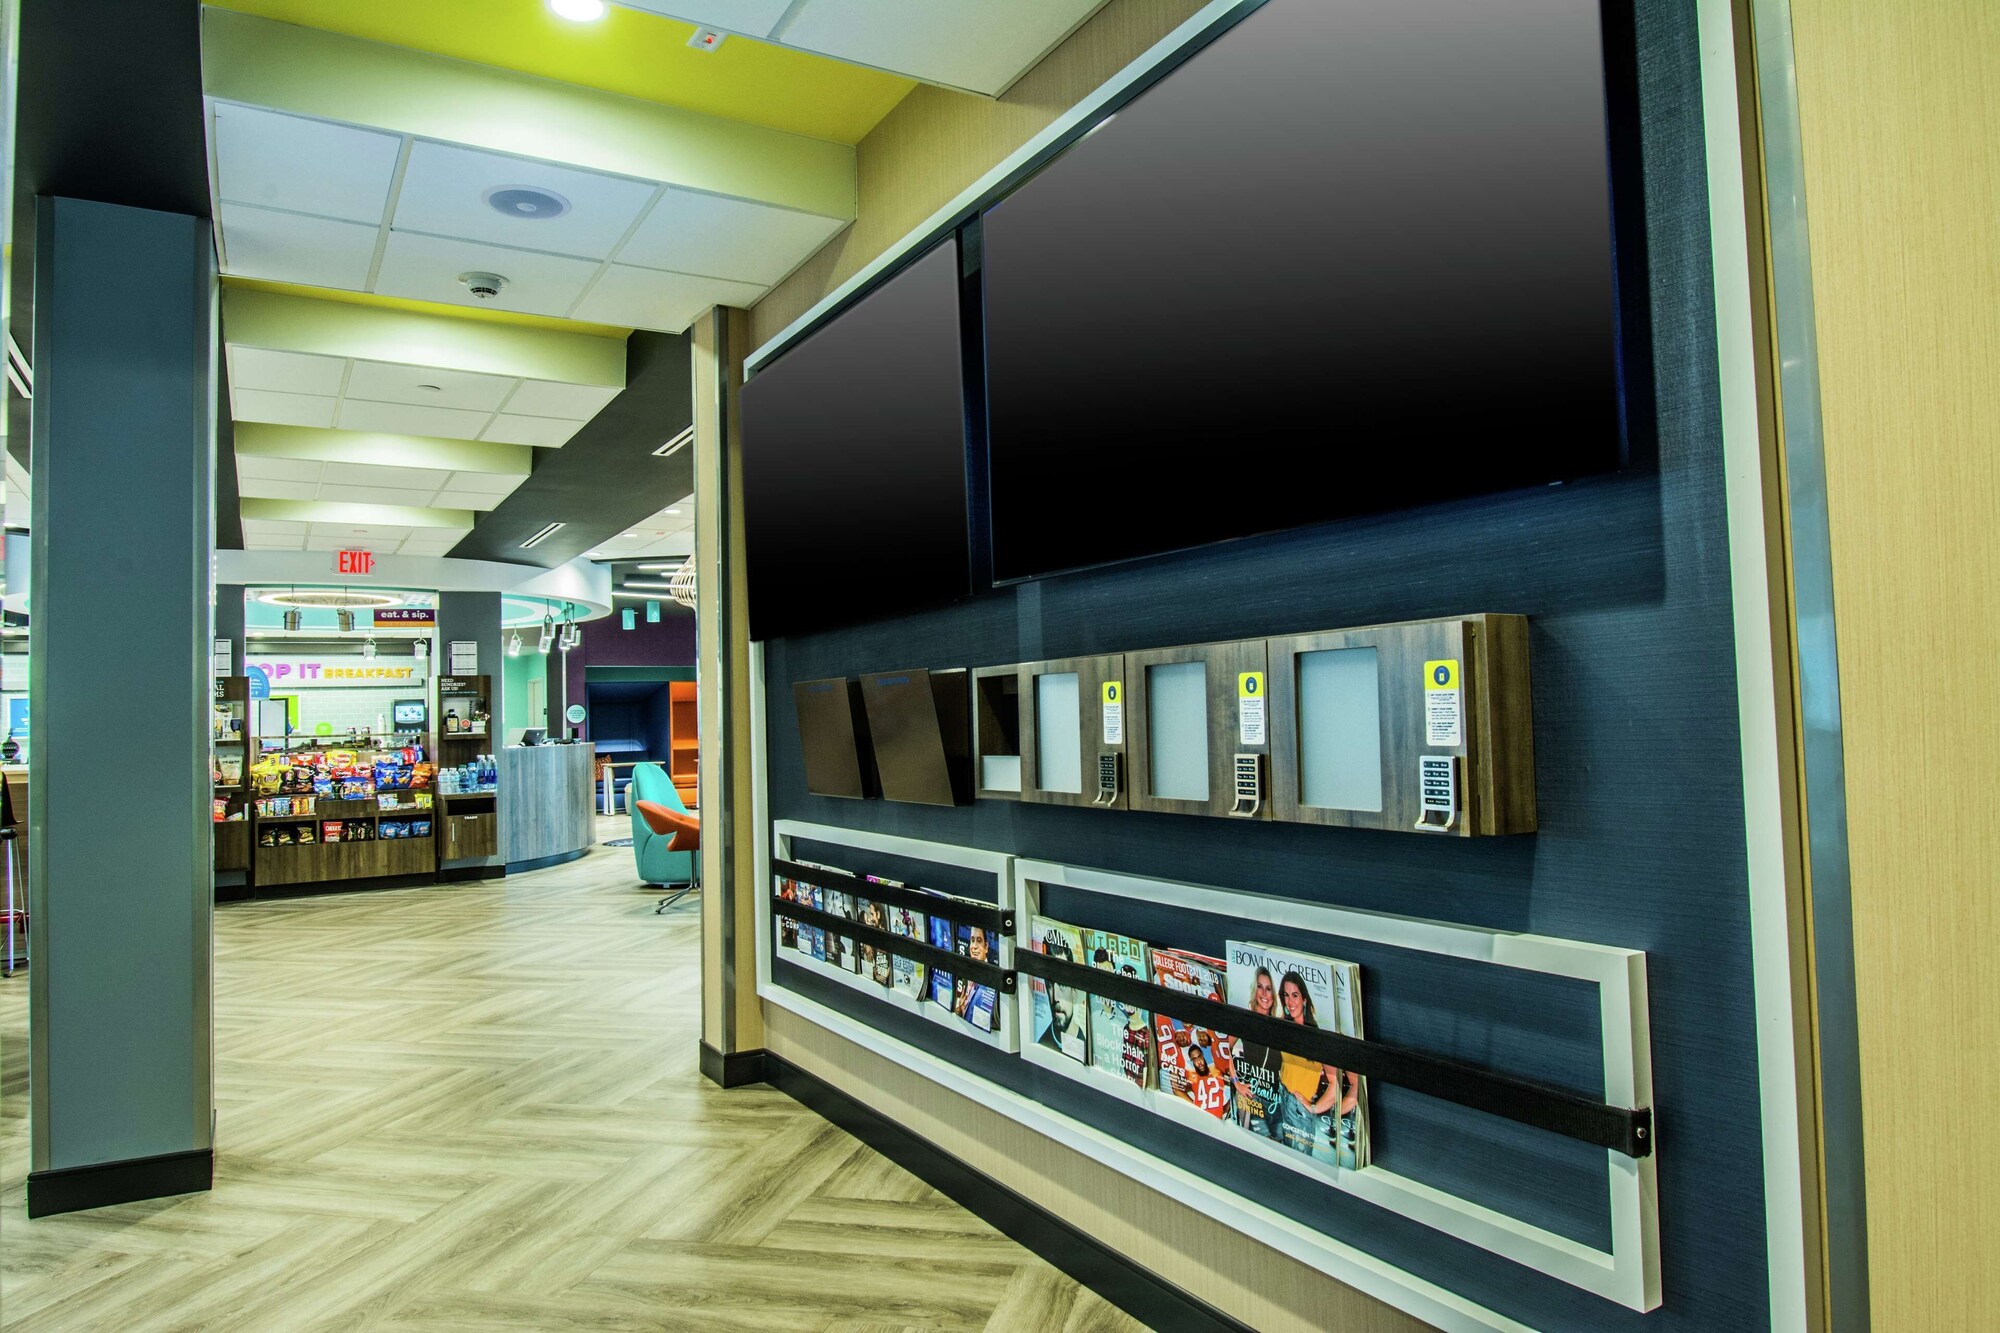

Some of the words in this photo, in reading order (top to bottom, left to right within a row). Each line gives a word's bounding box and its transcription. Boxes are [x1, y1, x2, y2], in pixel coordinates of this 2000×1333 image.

[339, 551, 372, 574] EXIT
[401, 610, 409, 618] &
[411, 610, 429, 620] sip.
[299, 663, 321, 679] IT
[323, 666, 413, 679] BREAKFAST
[1086, 931, 1140, 960] WIRED
[1106, 949, 1124, 965] The
[1153, 953, 1175, 971] COLLEGE
[1235, 950, 1287, 976] BOWLING
[1288, 963, 1327, 985] GREEN
[1111, 1023, 1129, 1040] The
[1113, 1053, 1140, 1075] Horror
[1160, 1053, 1177, 1066] BIG
[1161, 1061, 1186, 1077] CATS
[1236, 1059, 1275, 1083] HEALTH
[1237, 1095, 1263, 1110] ODOOR
[1250, 1077, 1278, 1115] Beauty
[1237, 1100, 1265, 1119] DINING
